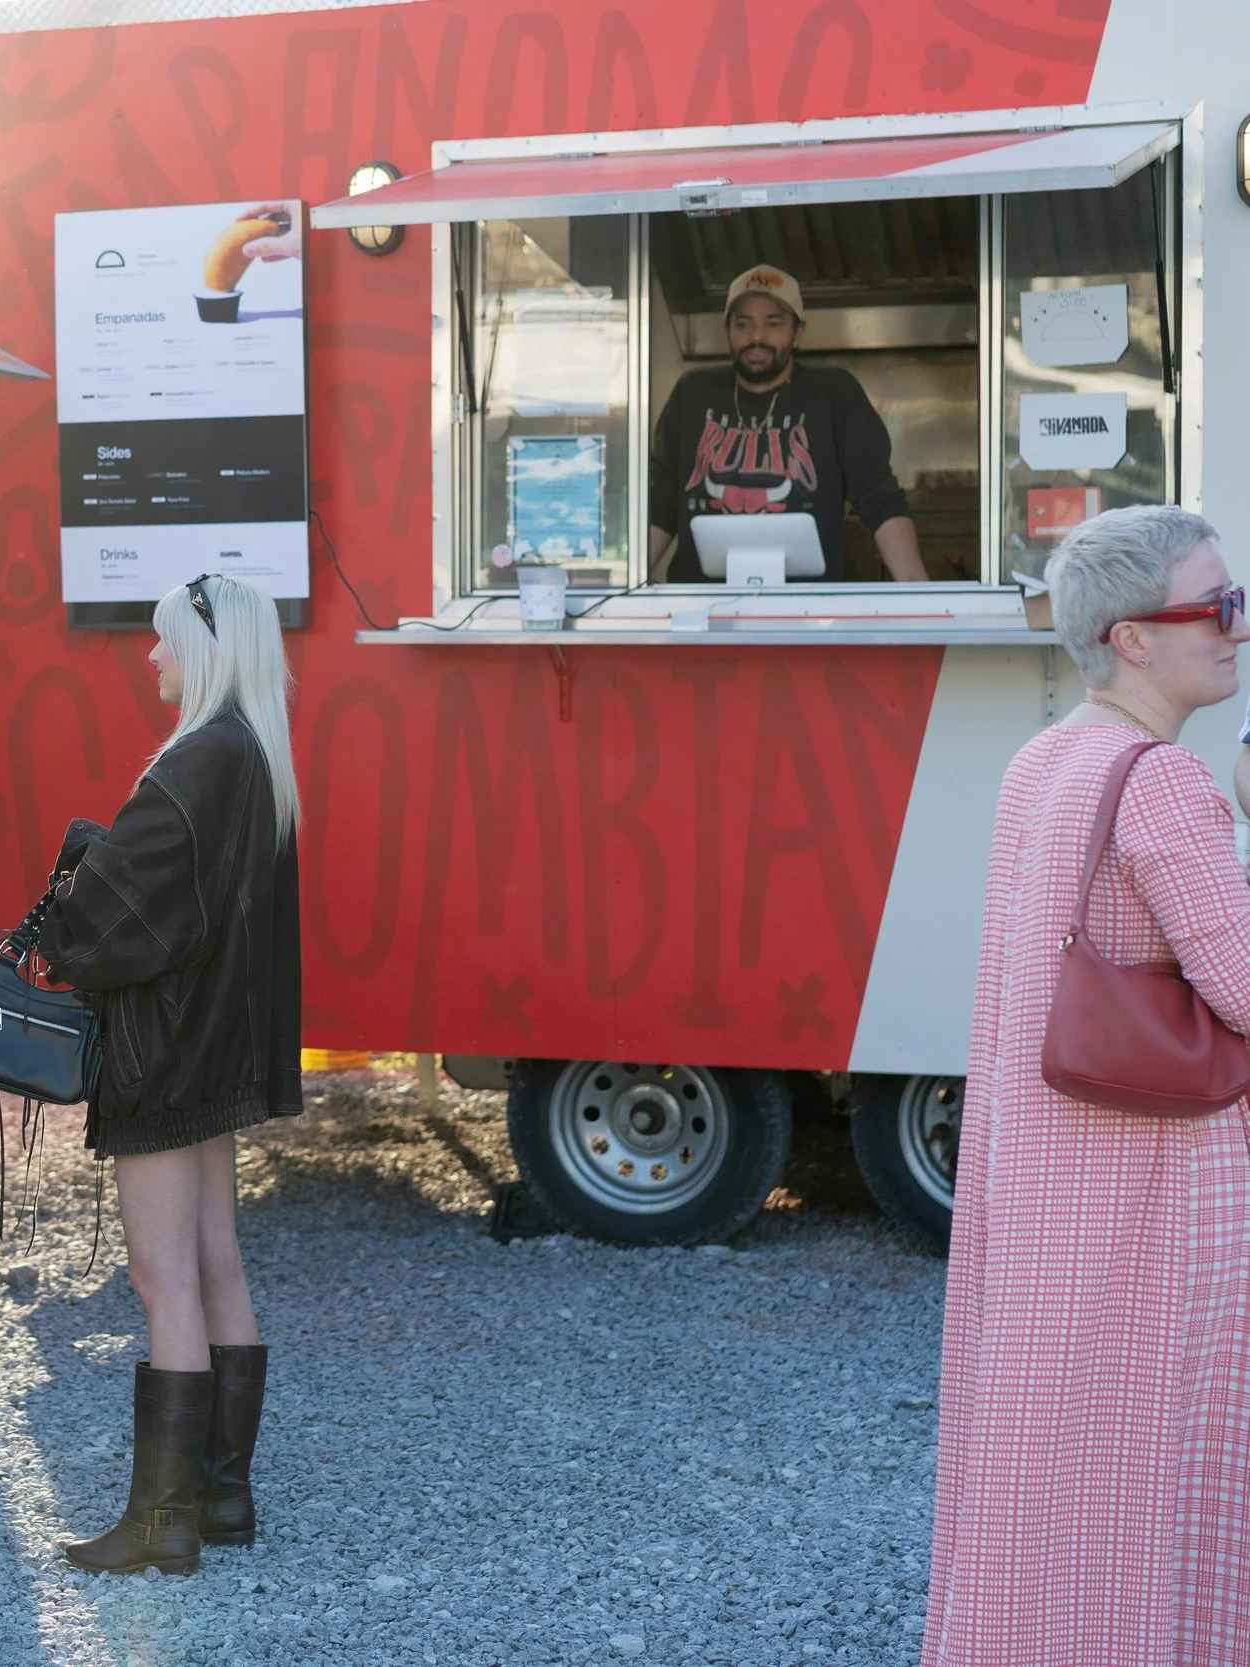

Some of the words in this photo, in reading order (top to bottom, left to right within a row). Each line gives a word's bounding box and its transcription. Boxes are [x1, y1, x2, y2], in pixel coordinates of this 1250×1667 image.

[95, 311, 166, 326] Empanadas
[97, 446, 132, 460] Sides
[684, 420, 818, 492] BULLS
[100, 548, 138, 561] Drinks
